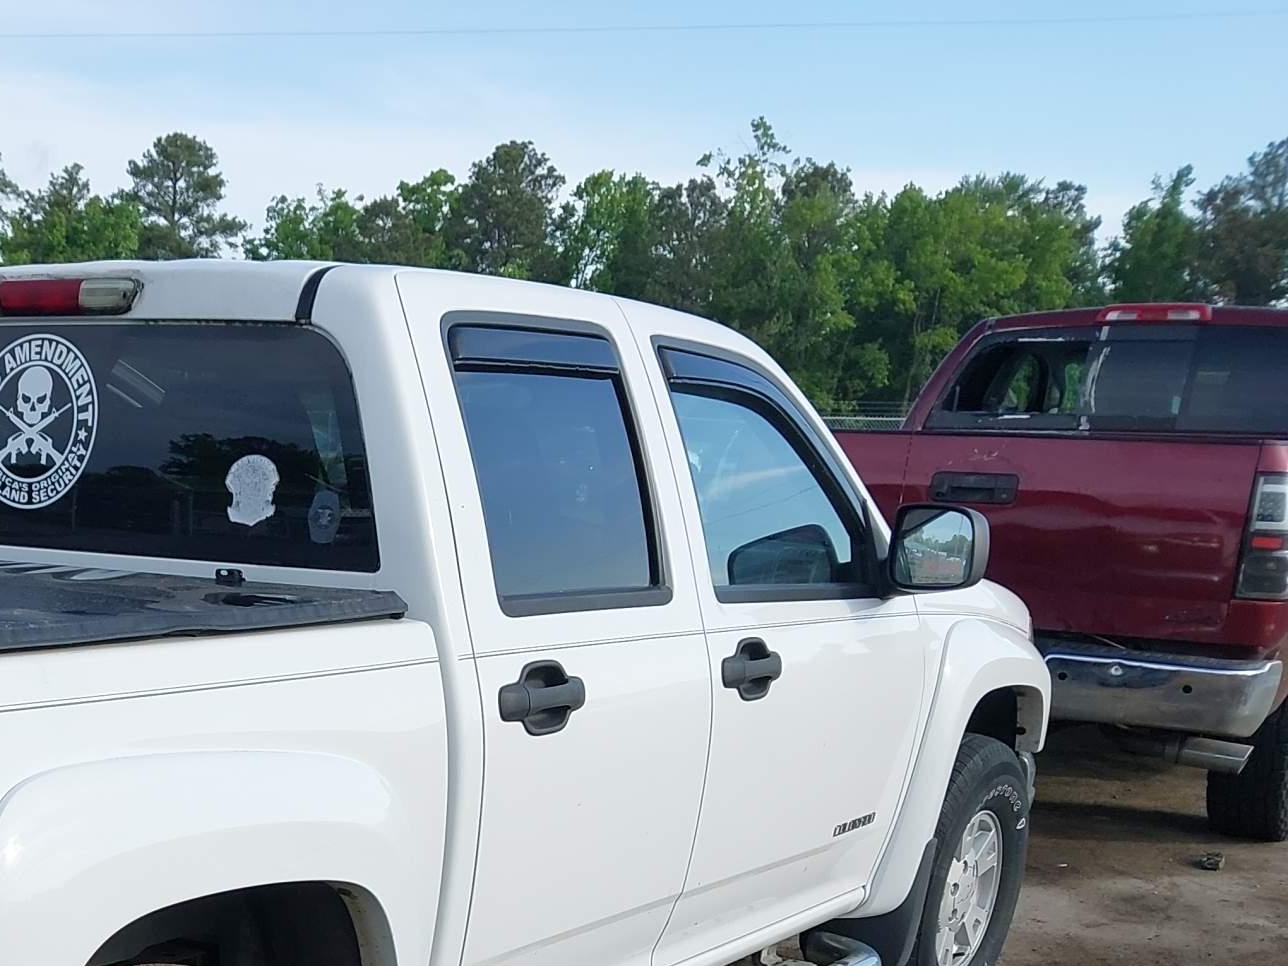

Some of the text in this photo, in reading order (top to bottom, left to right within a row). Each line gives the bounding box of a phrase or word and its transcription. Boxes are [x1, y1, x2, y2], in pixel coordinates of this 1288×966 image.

[4, 339, 93, 427] AMENDMENT
[31, 443, 80, 491] ORIGINAL
[31, 443, 87, 503] SECURITY
